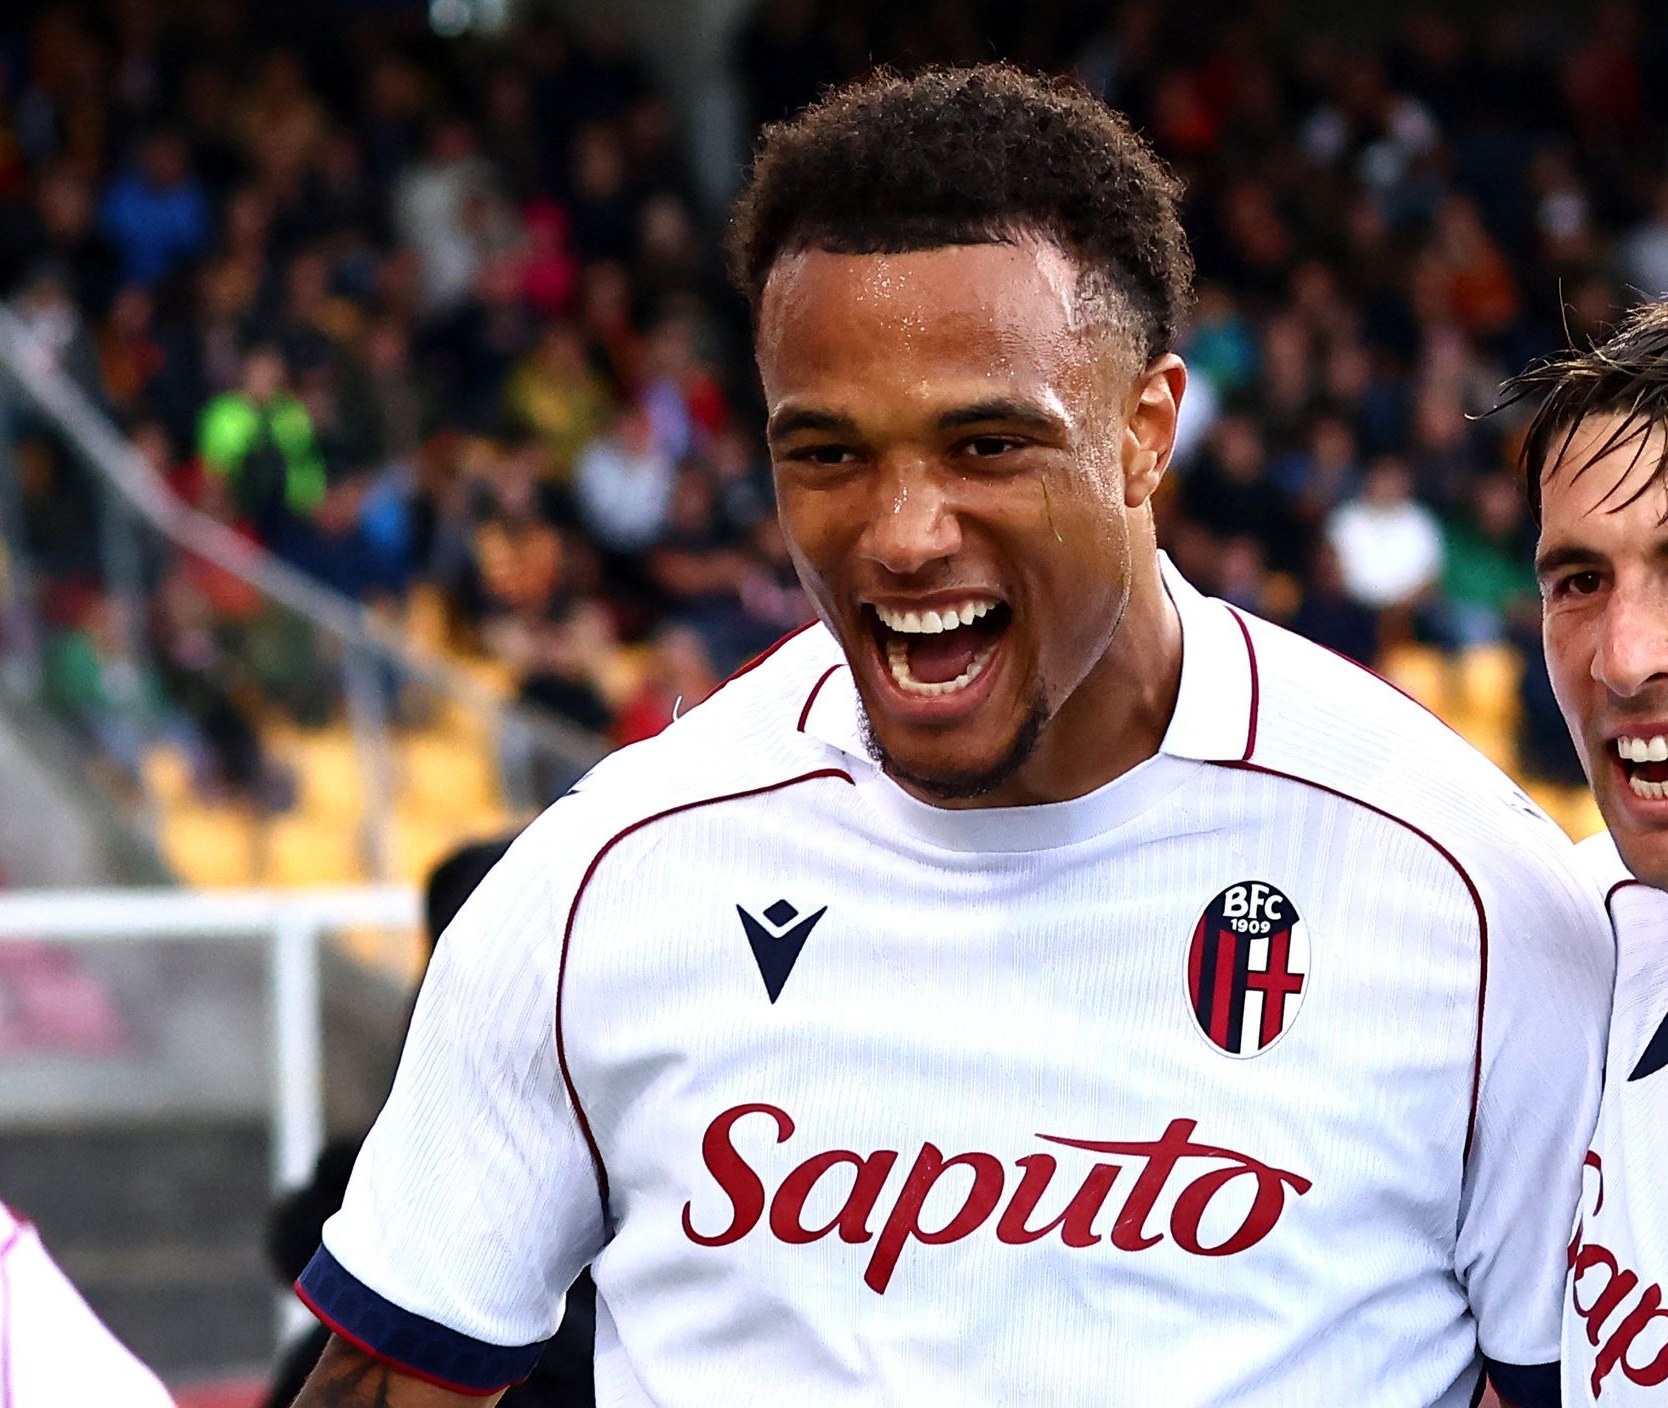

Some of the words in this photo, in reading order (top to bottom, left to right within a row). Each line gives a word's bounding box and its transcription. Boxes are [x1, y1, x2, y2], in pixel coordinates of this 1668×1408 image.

[1222, 883, 1284, 921] BFC
[1230, 918, 1271, 934] 1909
[682, 1103, 1312, 1295] Saputo
